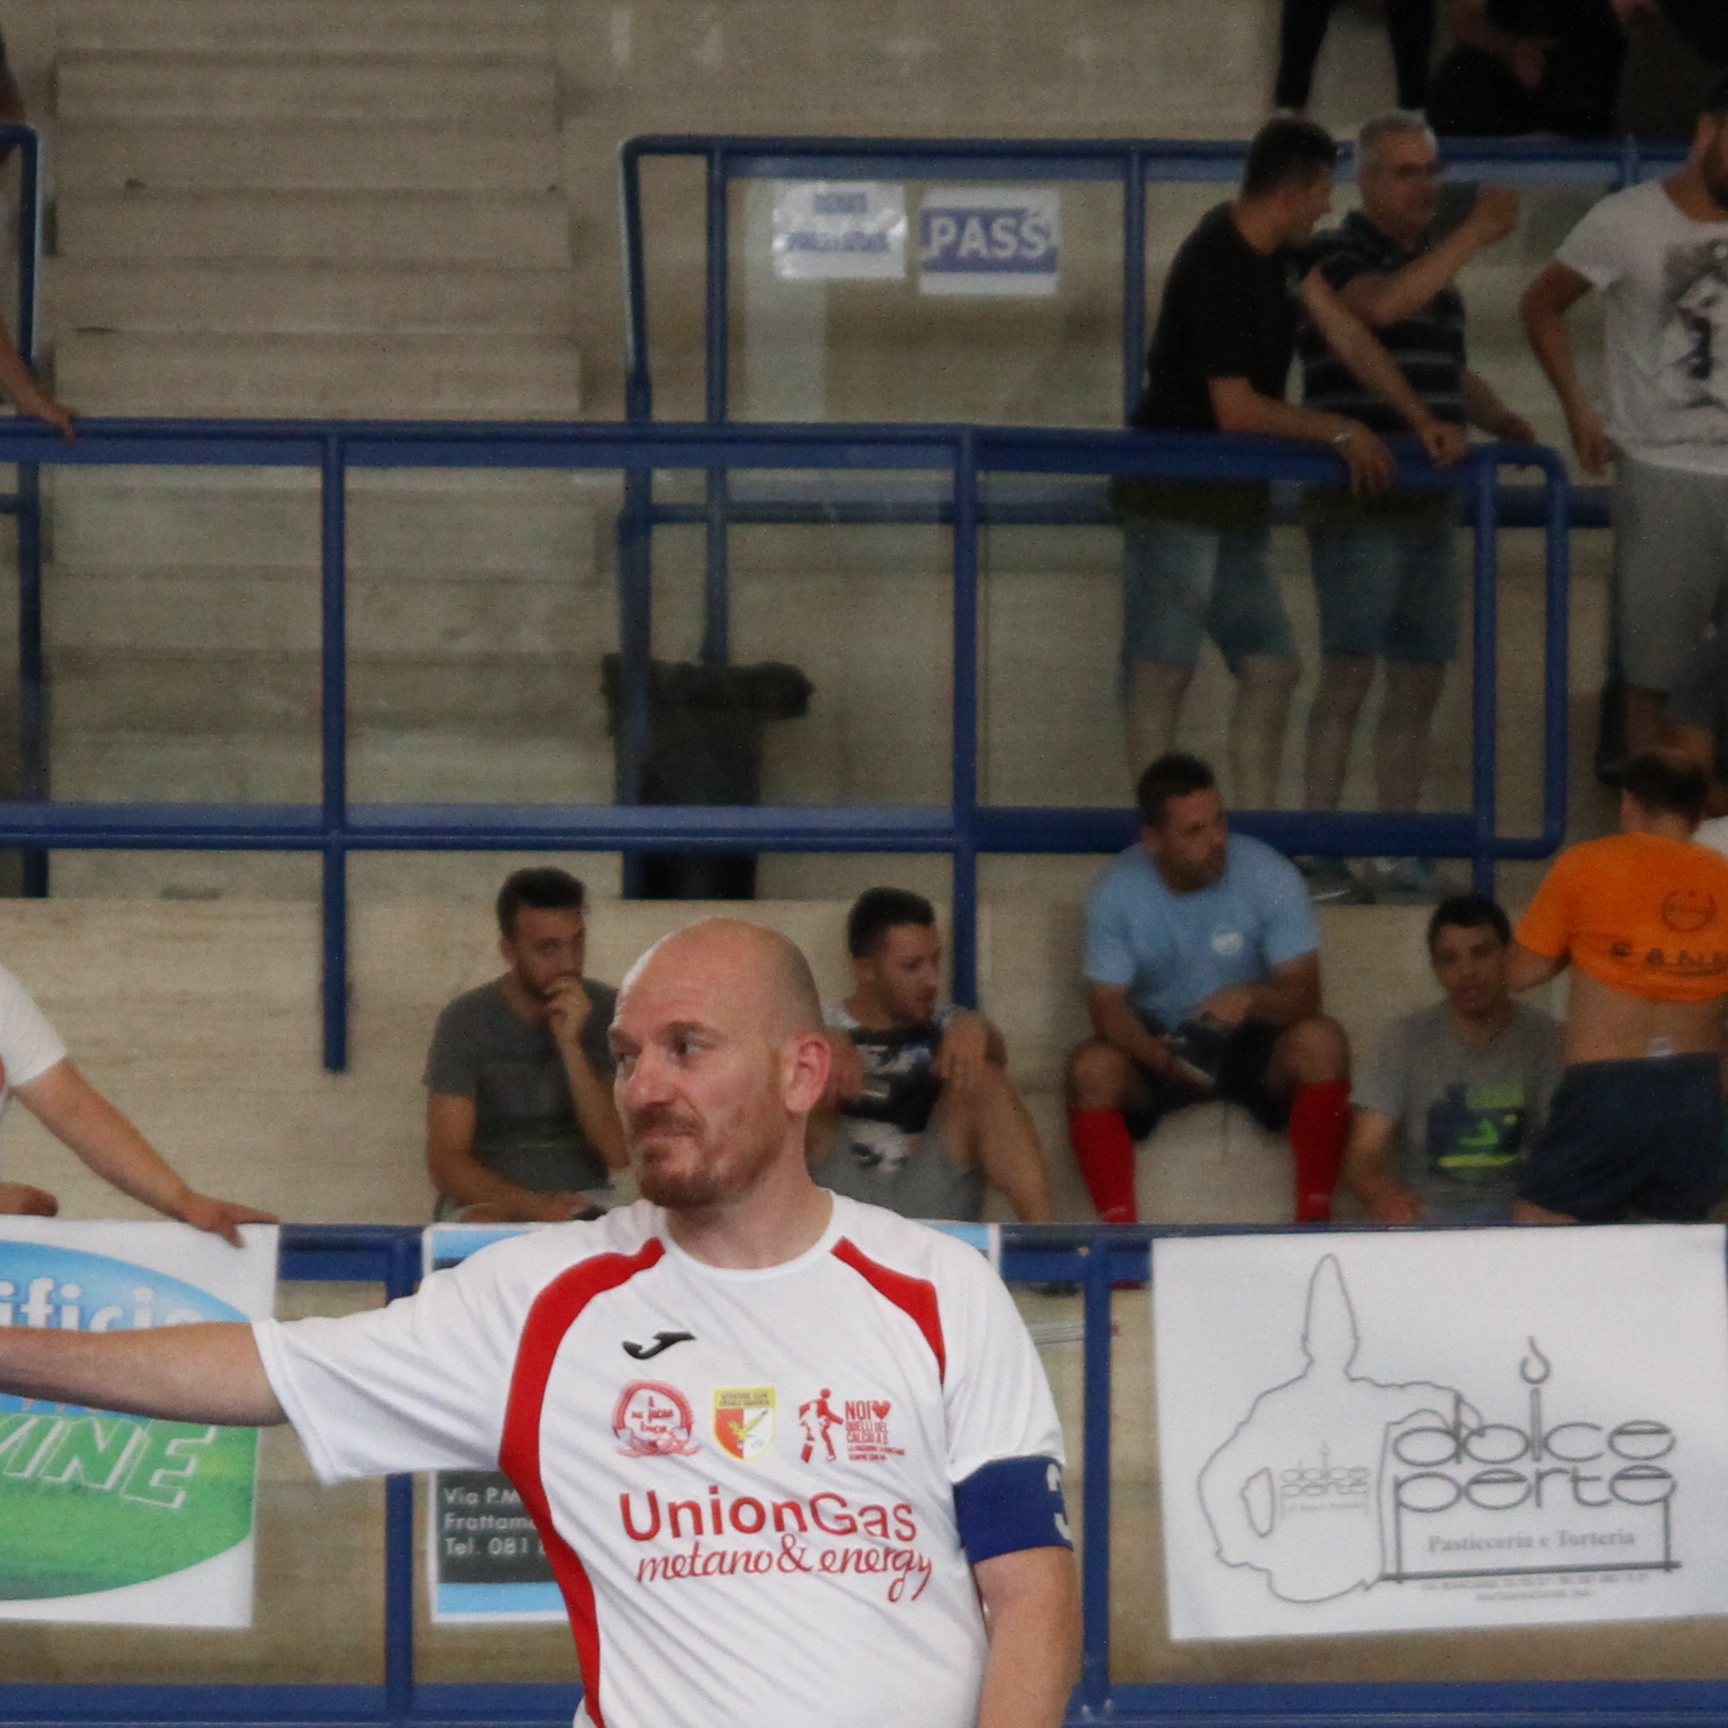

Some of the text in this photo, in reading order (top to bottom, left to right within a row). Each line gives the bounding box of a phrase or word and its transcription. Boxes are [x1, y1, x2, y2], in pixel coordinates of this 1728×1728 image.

[929, 213, 1052, 259] PASS
[845, 1400, 871, 1420] NOI
[444, 1486, 479, 1504] Via
[618, 1486, 918, 1542] UnionGas
[487, 1536, 529, 1556] 081
